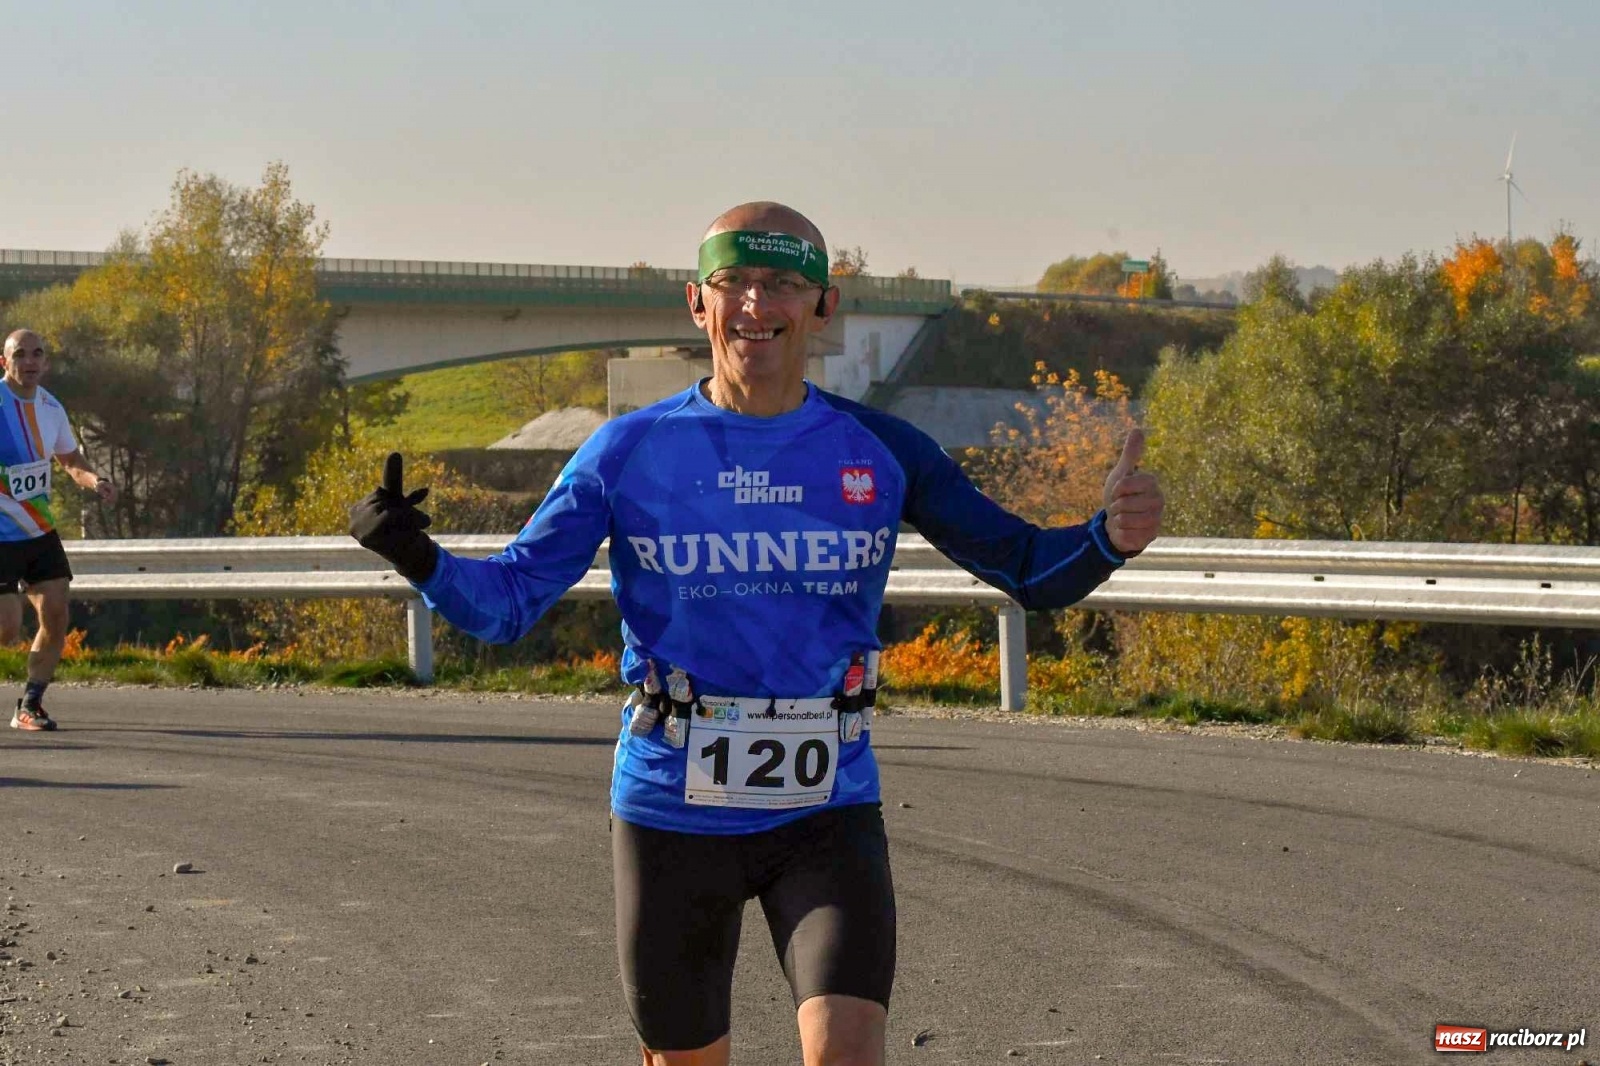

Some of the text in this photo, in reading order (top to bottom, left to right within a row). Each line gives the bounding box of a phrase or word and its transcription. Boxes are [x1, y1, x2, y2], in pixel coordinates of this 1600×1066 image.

[739, 235, 801, 250] PÓŁMARATON
[12, 471, 47, 495] 201
[627, 526, 891, 576] RUNNERS
[802, 580, 858, 596] TEAM
[701, 736, 830, 788] 120
